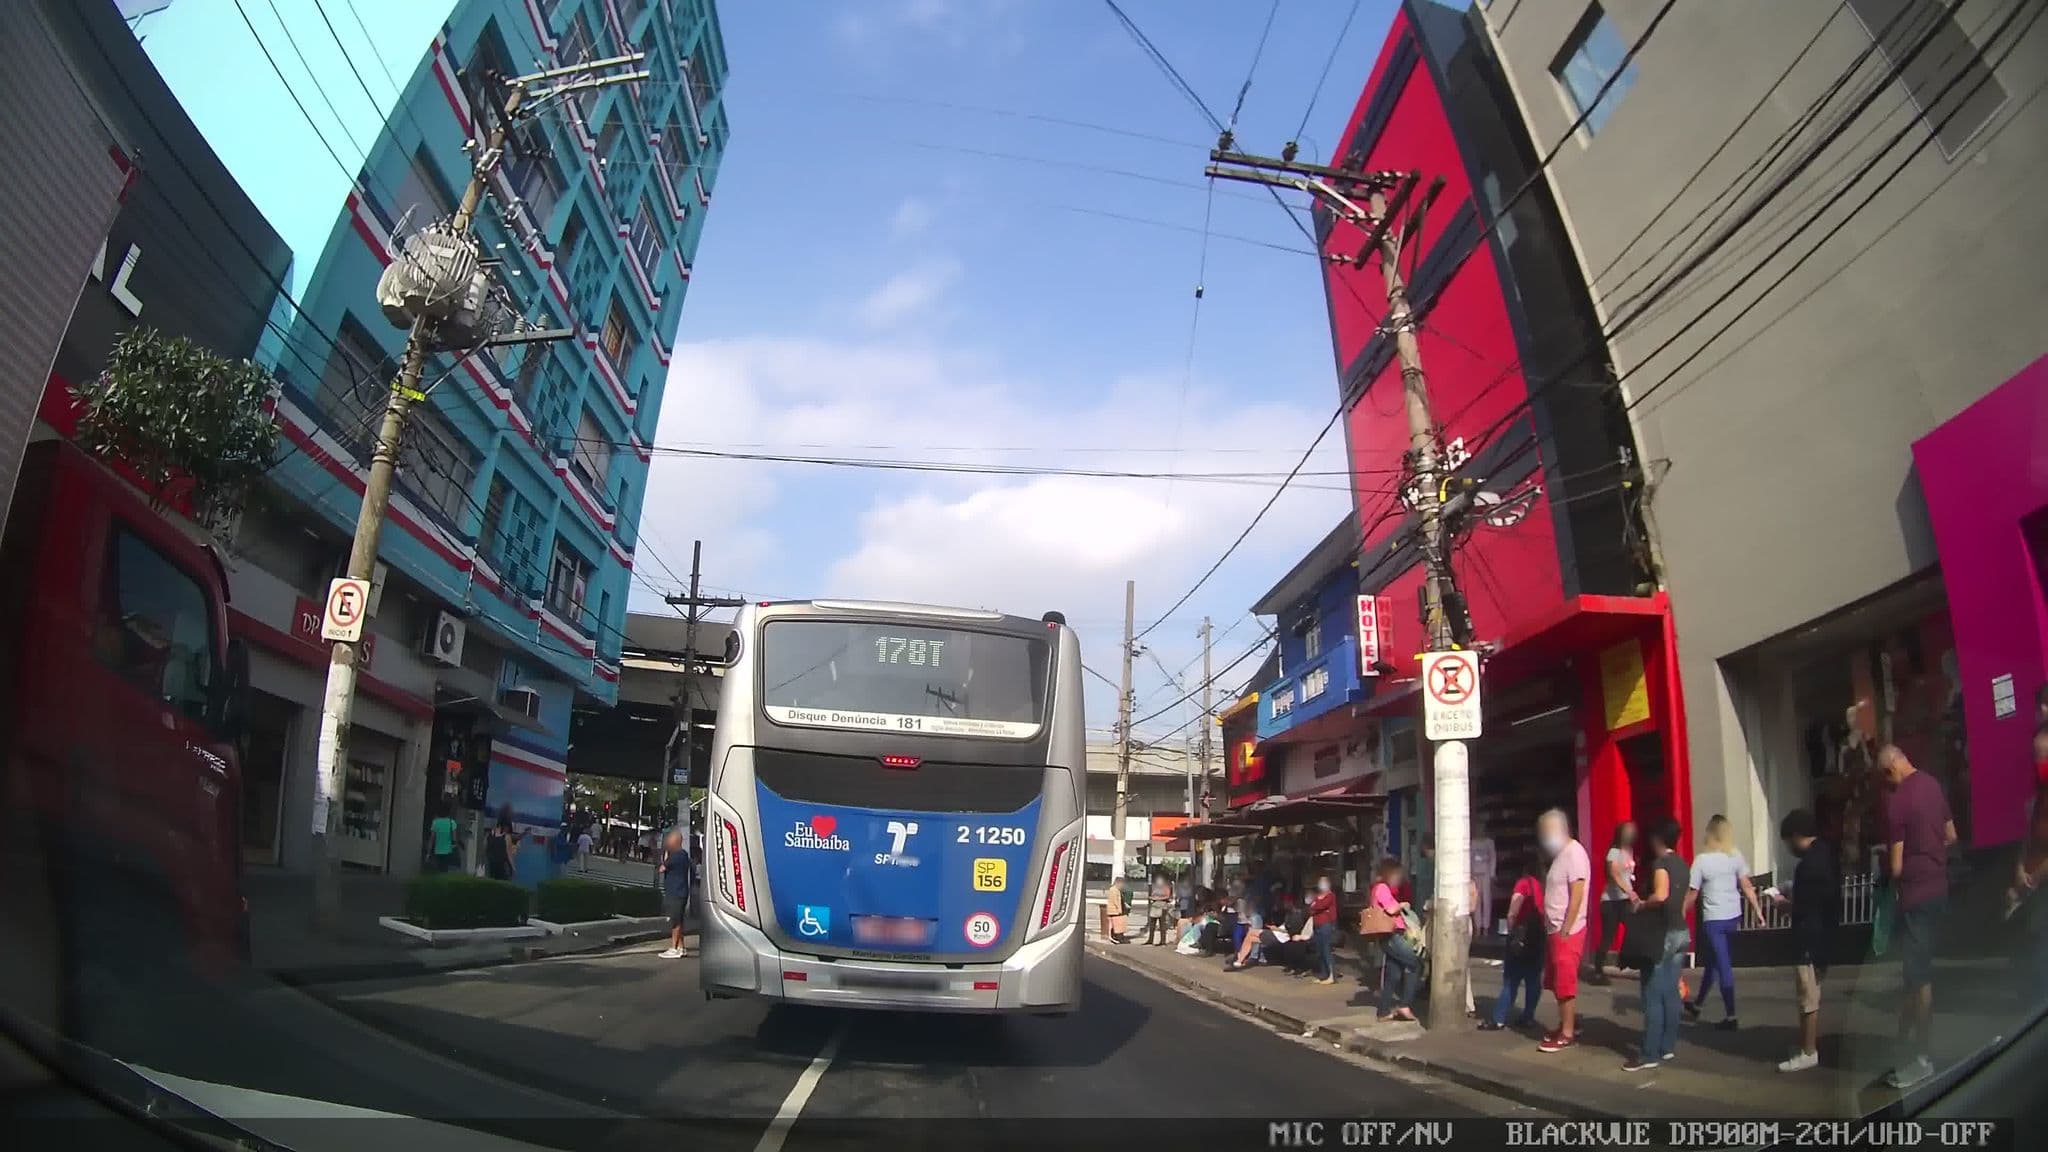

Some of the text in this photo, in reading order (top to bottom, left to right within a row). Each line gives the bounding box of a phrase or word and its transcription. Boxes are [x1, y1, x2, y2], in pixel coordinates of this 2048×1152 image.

[875, 636, 944, 667] 178T
[788, 710, 827, 722] Disque
[831, 713, 887, 726] Denúncia
[896, 717, 922, 730] 181
[795, 822, 813, 837] Eu
[975, 827, 1026, 846] 1250
[784, 831, 850, 851] Sambaíba
[977, 863, 995, 874] SP
[977, 876, 1002, 888] 156
[974, 921, 990, 932] 50
